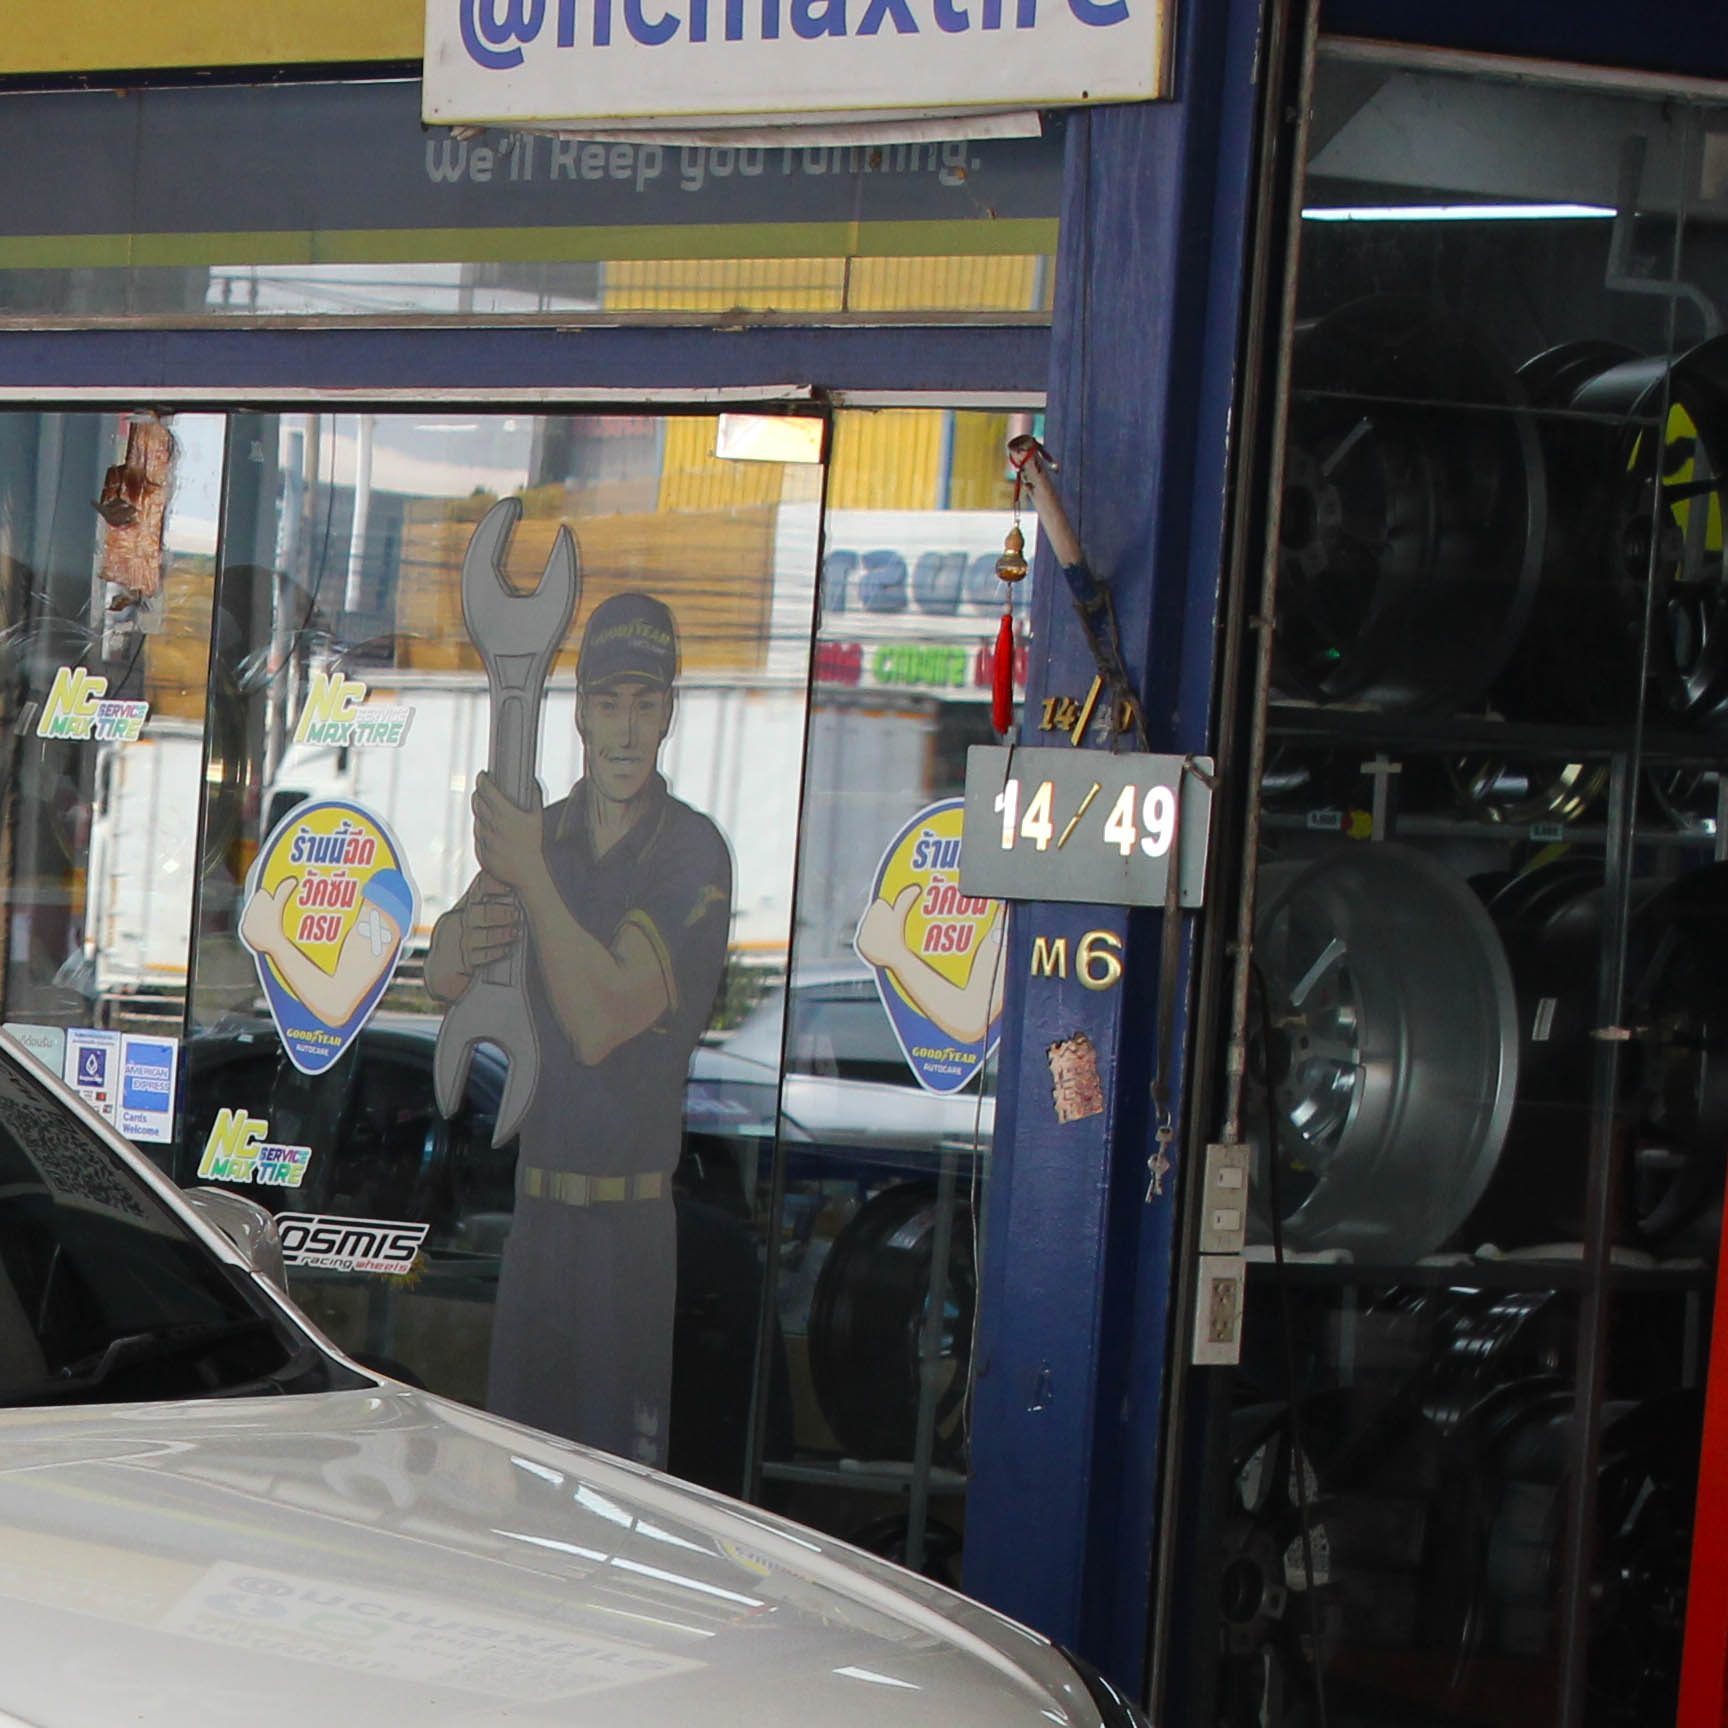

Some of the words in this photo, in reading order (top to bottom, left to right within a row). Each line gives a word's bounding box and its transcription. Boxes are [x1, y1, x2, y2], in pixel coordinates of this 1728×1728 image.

[680, 145, 765, 192] you
[40, 669, 105, 734] NC
[297, 675, 364, 743] NC
[51, 716, 92, 736] MAX
[95, 718, 143, 739] TIRE
[308, 722, 352, 744] MAX
[355, 723, 403, 745] TIRE
[994, 779, 1178, 858] 14/49
[286, 1030, 342, 1047] GOODYEAR
[912, 1047, 976, 1065] GOODYEAR
[126, 1065, 169, 1077] AMERICAN
[133, 1079, 169, 1091] EXPRESS
[123, 1111, 148, 1123] Cards
[122, 1123, 160, 1137] Welcome
[200, 1109, 268, 1175] NC
[259, 1147, 309, 1163] SERVICE
[211, 1158, 255, 1180] MAX
[258, 1161, 304, 1184] TIRE
[301, 1254, 353, 1270] racing
[356, 1260, 410, 1274] wheels
